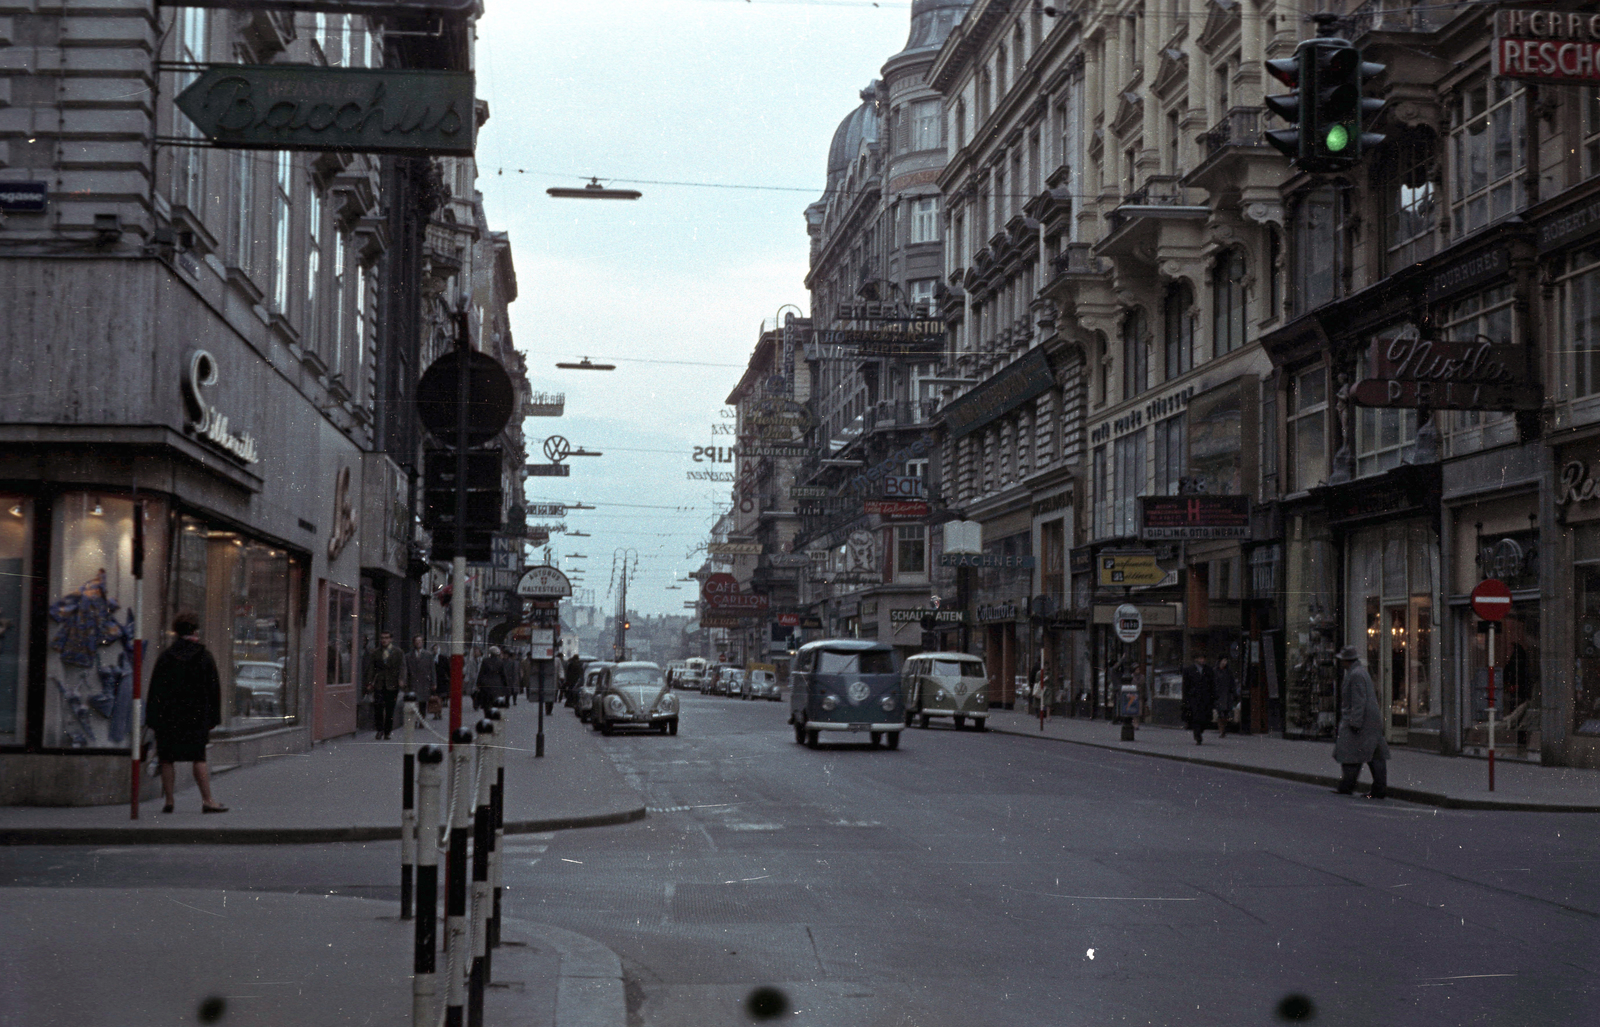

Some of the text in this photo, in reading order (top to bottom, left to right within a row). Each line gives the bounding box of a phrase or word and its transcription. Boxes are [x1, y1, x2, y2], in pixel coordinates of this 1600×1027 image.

[203, 75, 462, 137] Bacchus
[885, 476, 922, 496] Bar
[796, 507, 820, 515] FILM
[941, 555, 1024, 567] PRACHNER
[529, 569, 561, 581] AUTOBUS
[975, 603, 1016, 622] Columbia
